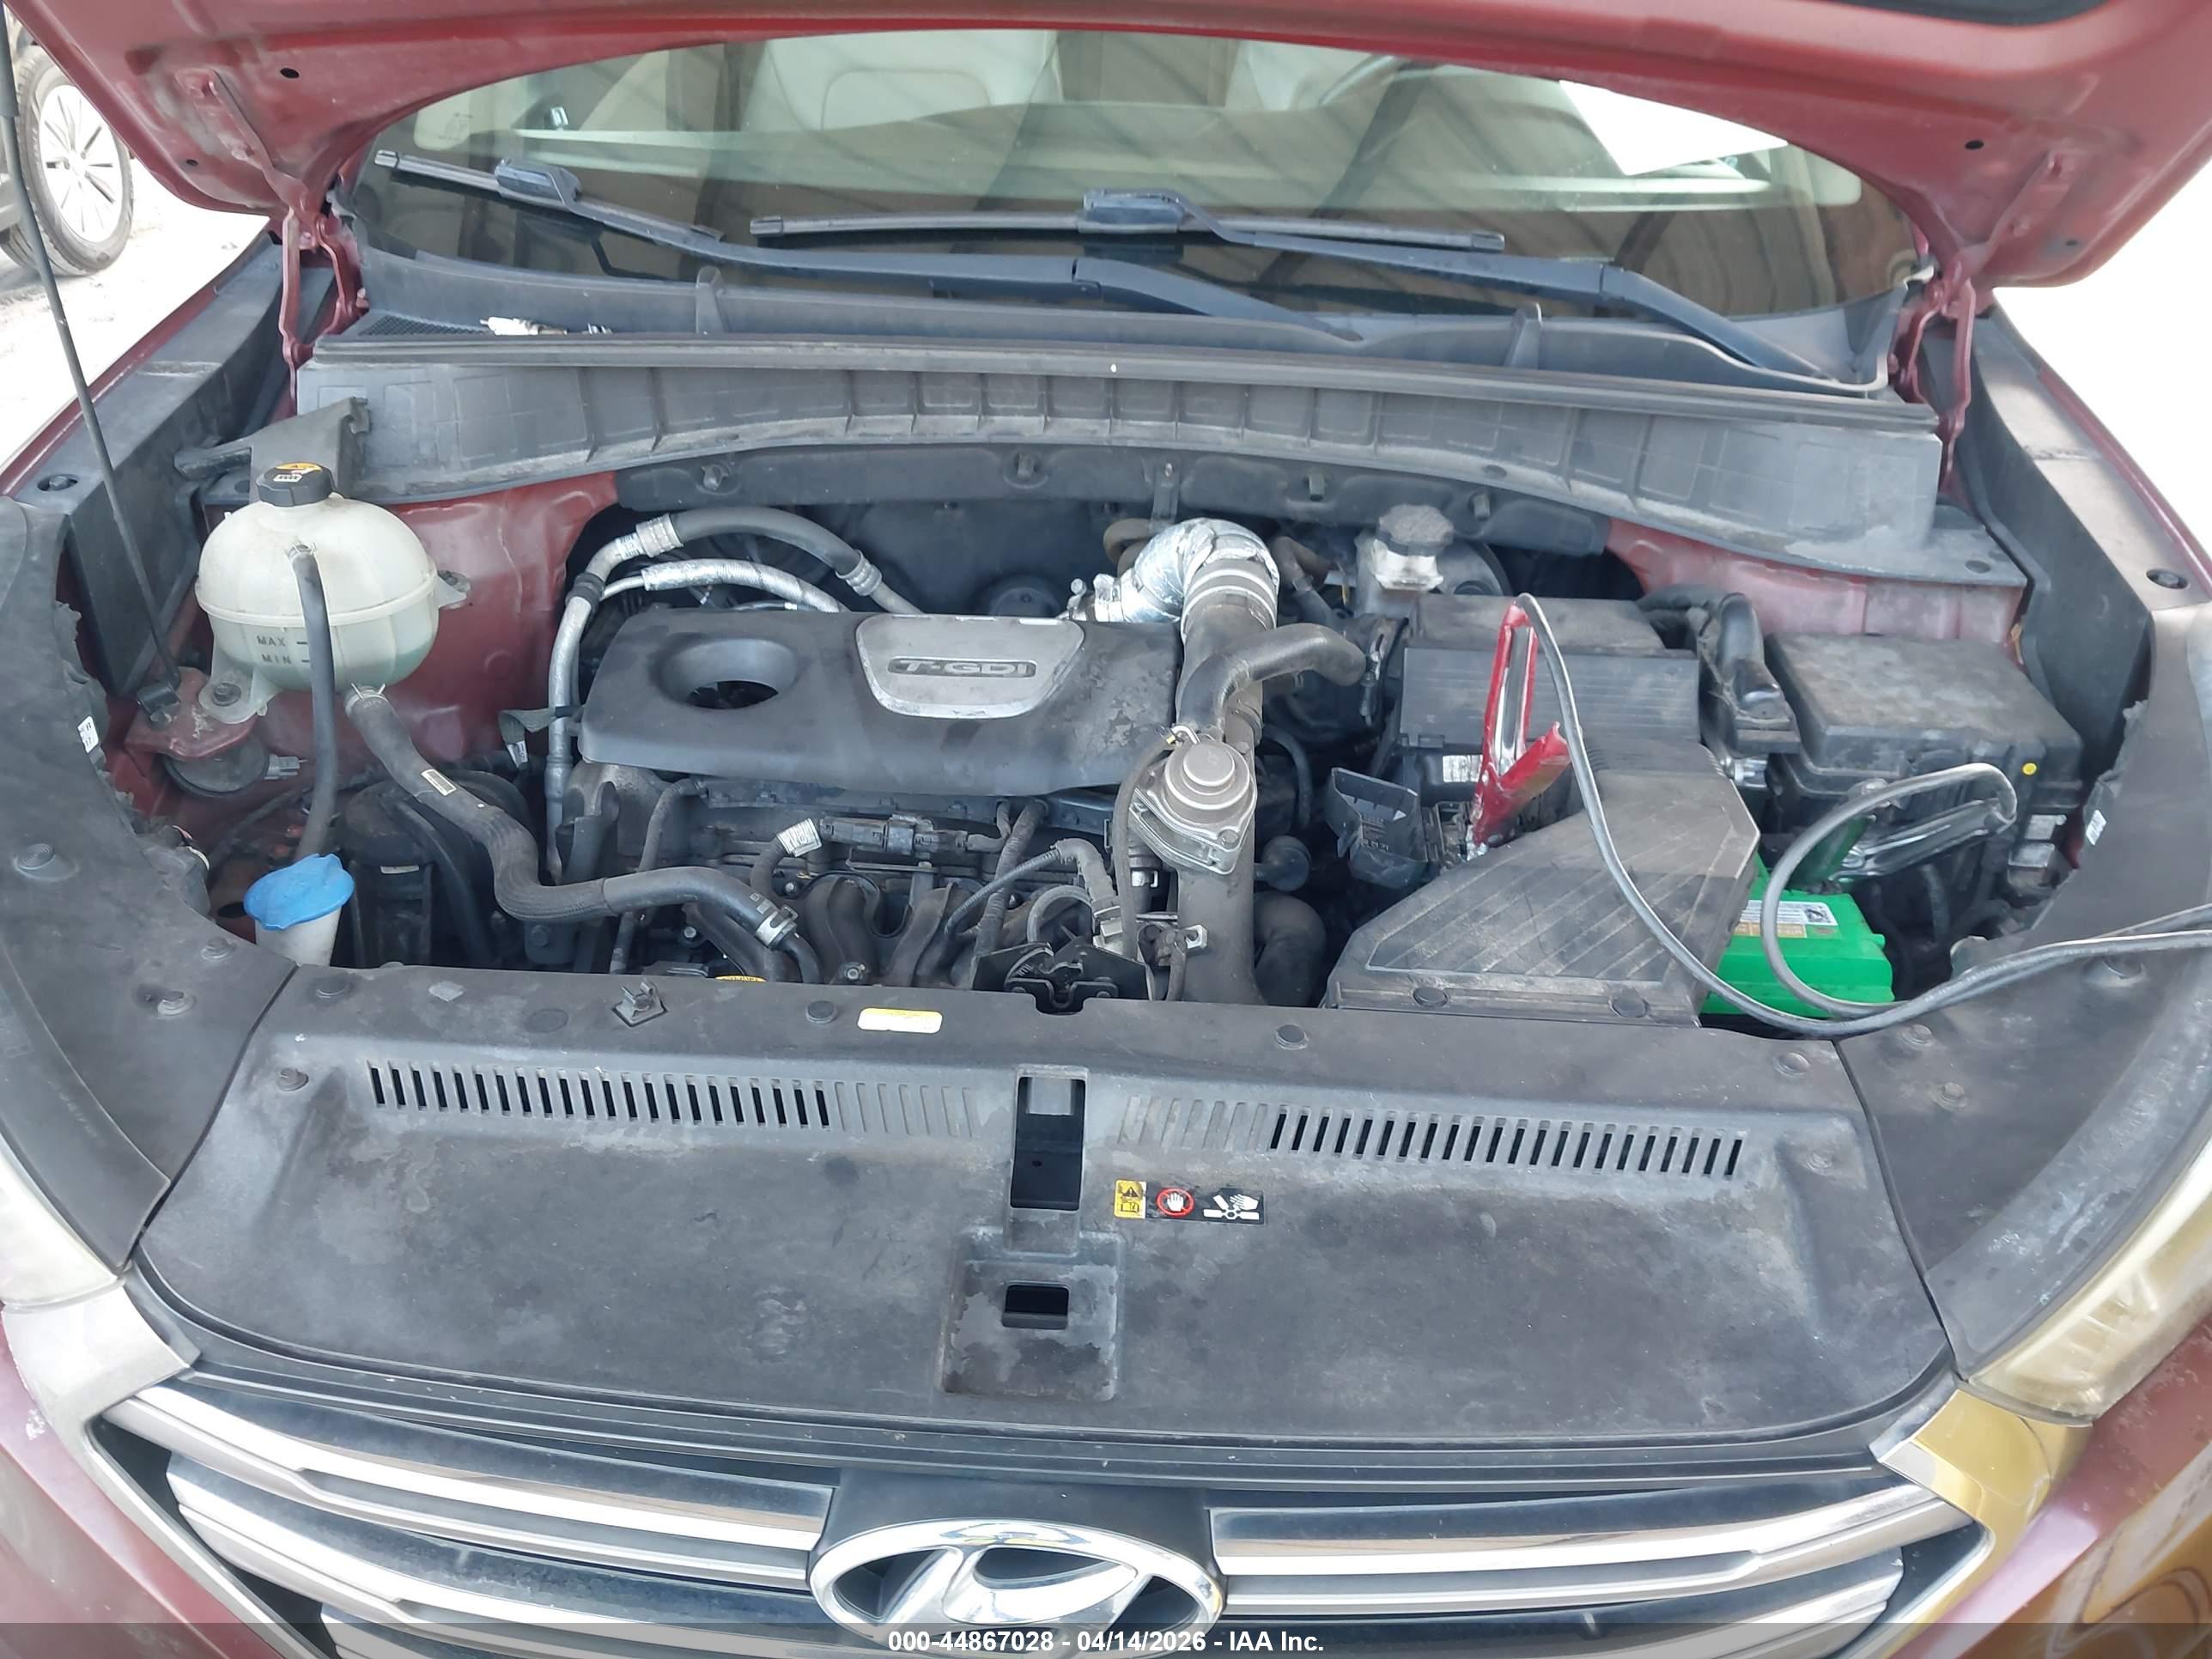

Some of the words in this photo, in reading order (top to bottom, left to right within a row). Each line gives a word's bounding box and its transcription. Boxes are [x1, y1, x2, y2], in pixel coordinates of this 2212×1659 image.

[256, 635, 286, 647] MAX
[261, 653, 291, 665] MIN
[899, 659, 1027, 675] T-GDI
